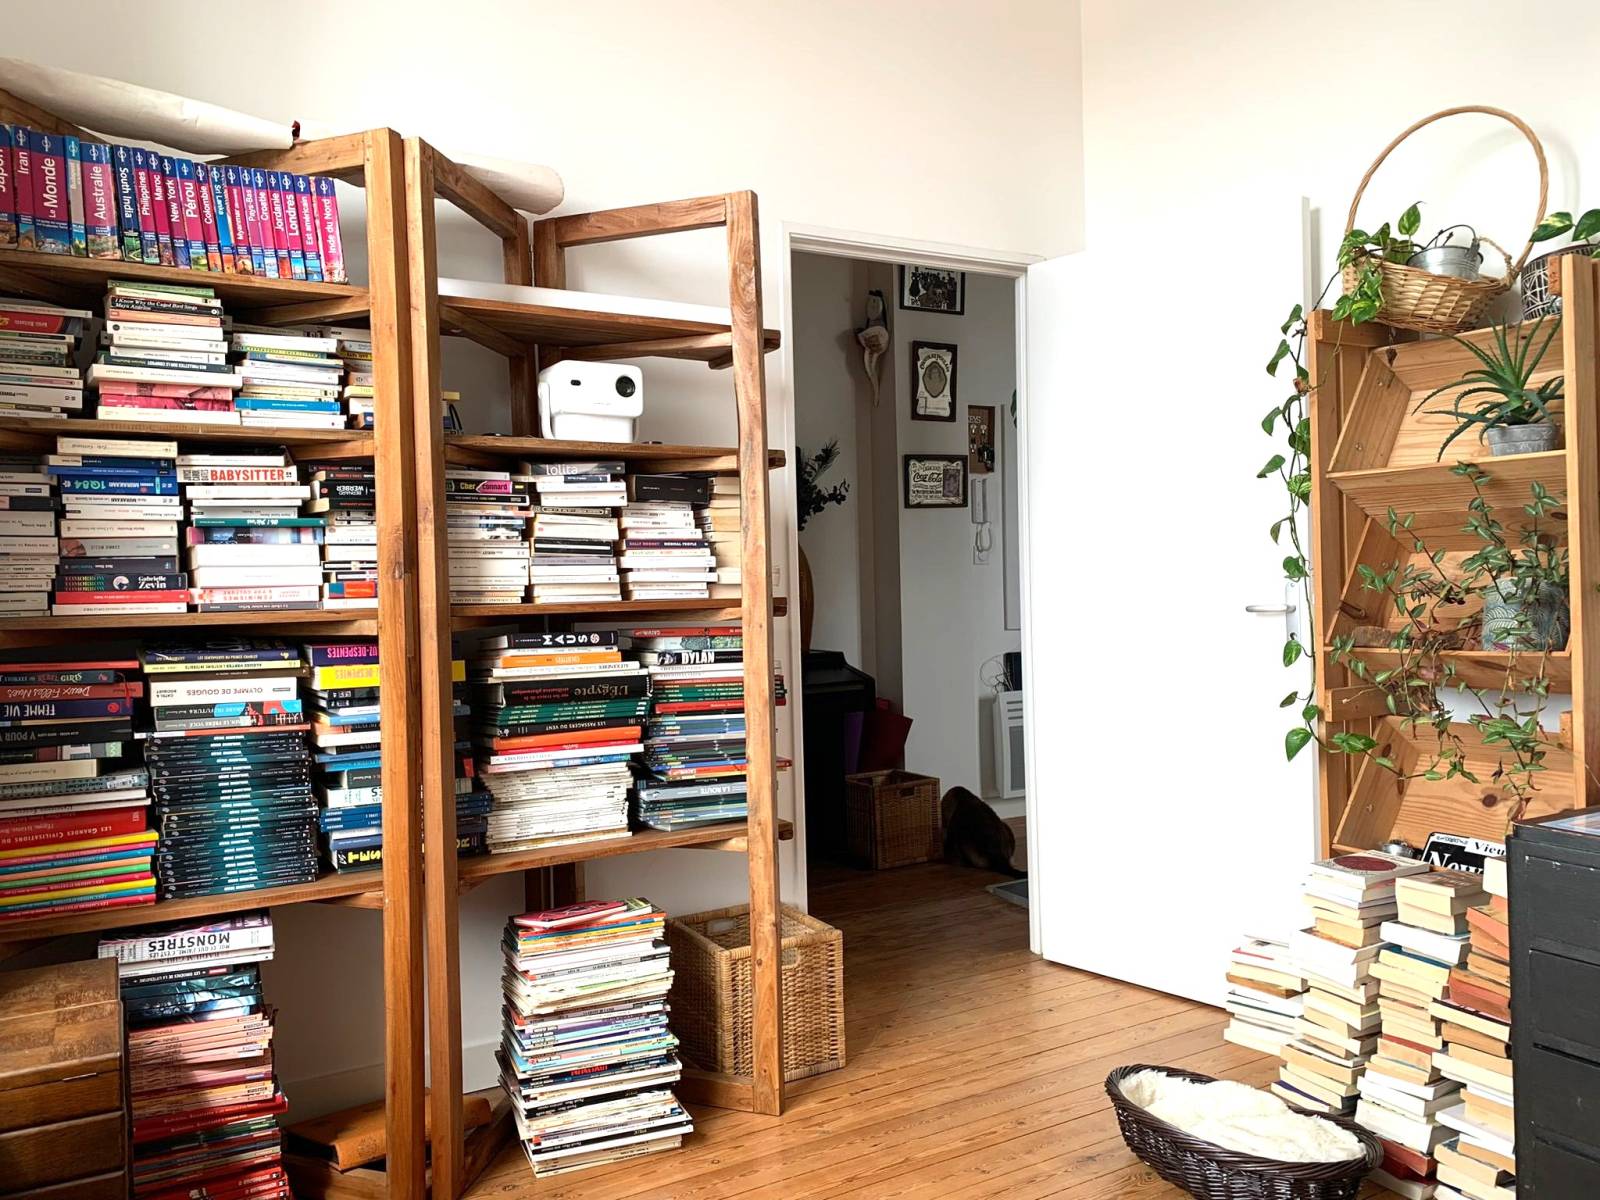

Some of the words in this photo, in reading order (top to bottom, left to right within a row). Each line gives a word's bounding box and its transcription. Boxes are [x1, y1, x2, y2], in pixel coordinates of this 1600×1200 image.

[17, 151, 29, 175] Iran
[41, 157, 59, 208] Monde
[119, 167, 130, 193] South
[94, 165, 108, 221] Australie
[137, 171, 150, 216] Philippines
[152, 174, 164, 201] Maroc
[165, 179, 177, 199] York
[214, 184, 223, 194] Sri
[183, 181, 198, 218] Pérou
[200, 185, 213, 224] Colombie
[216, 196, 225, 216] Lanka
[244, 189, 256, 222] Pays-Bas
[257, 191, 269, 221] Croatie
[122, 195, 133, 218] India
[169, 201, 181, 223] New
[271, 192, 284, 232] Jordanie
[321, 198, 333, 219] Nord
[48, 209, 57, 218] Le
[285, 194, 299, 236] Londres
[300, 195, 312, 232] américain
[233, 208, 244, 240] Myanmar
[325, 221, 334, 233] du
[305, 233, 315, 246] Est
[327, 236, 338, 254] Inde
[210, 469, 285, 481] BABYSITTER
[545, 463, 578, 475] lolita
[73, 481, 106, 490] 1Q84
[459, 482, 476, 491] Cher
[138, 581, 167, 589] Zevin
[542, 633, 588, 645] MAUS
[327, 646, 378, 658] UZ-DESPENTES
[681, 651, 715, 664] DYLAN
[60, 672, 82, 682] GIRLS
[7, 688, 31, 698] Nues
[33, 687, 61, 698] Filles
[63, 685, 92, 696] Deux
[186, 688, 220, 696] GOUGES
[233, 686, 263, 694] OLYMPE
[575, 683, 629, 697] L'Égypte
[3, 705, 20, 717] VIE
[24, 703, 56, 716] FEMME
[5, 732, 28, 740] POUR
[30, 732, 36, 740] V
[14, 832, 64, 842] CIVILISATIONS
[67, 828, 98, 836] GRANDES
[148, 932, 230, 952] MONSTRES
